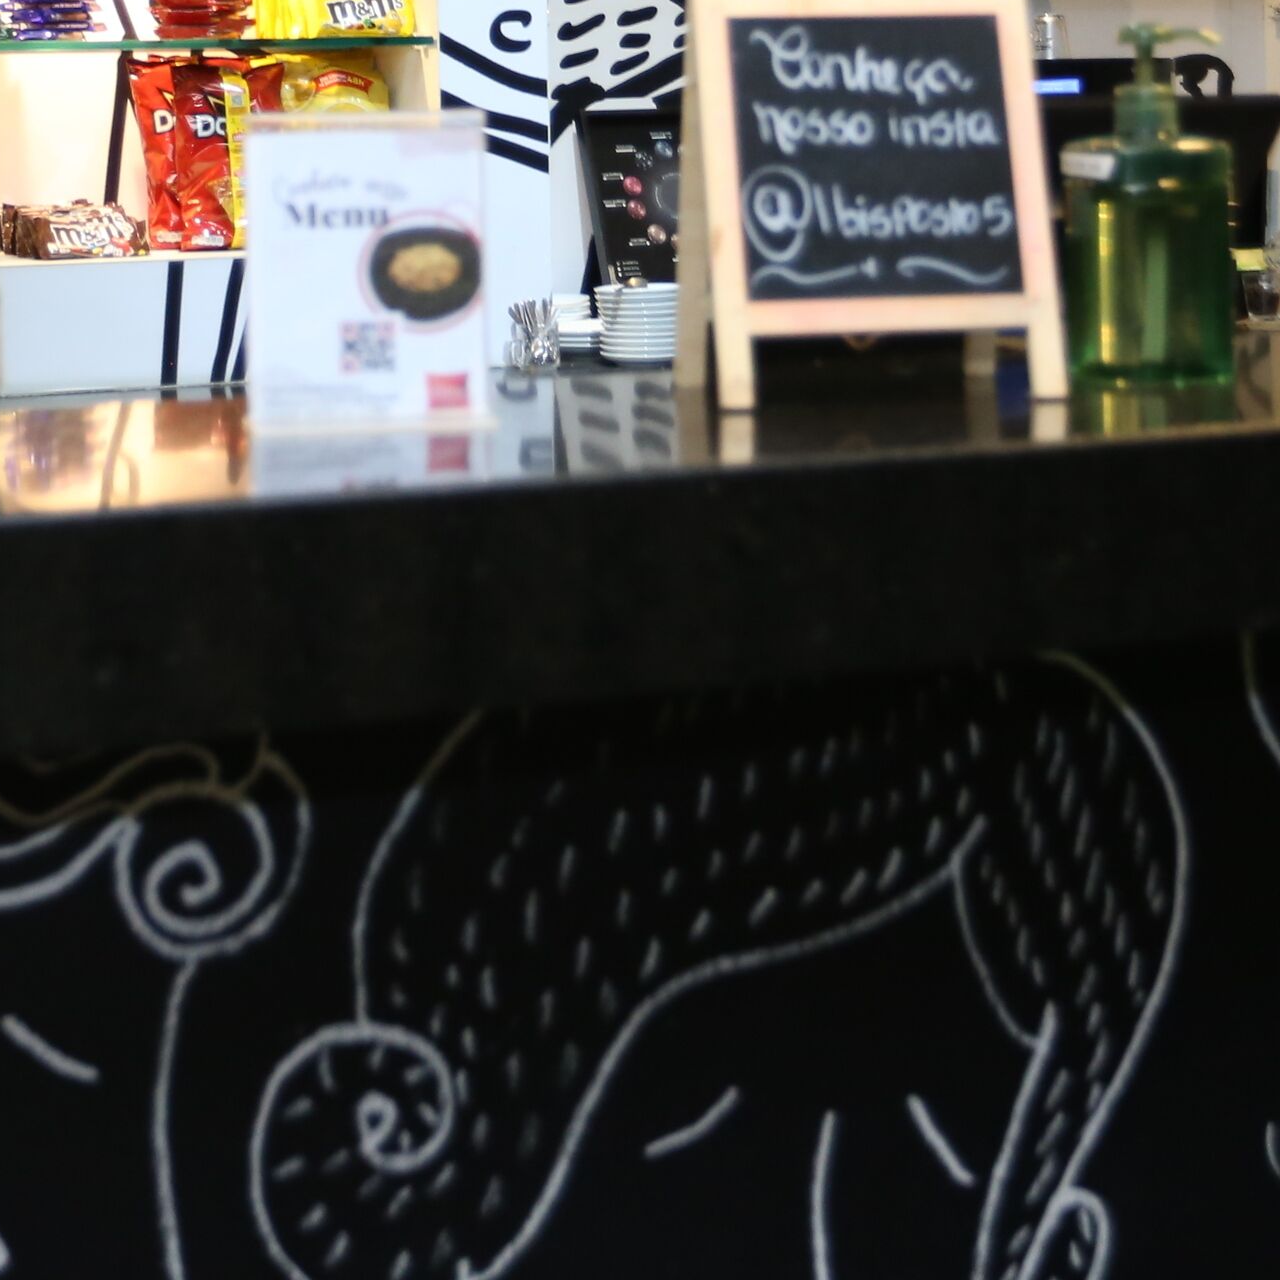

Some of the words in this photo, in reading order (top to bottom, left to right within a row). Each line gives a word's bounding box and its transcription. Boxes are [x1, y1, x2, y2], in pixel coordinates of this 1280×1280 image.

[752, 102, 874, 156] nosso
[888, 108, 1001, 148] insta
[286, 203, 390, 229] Menu
